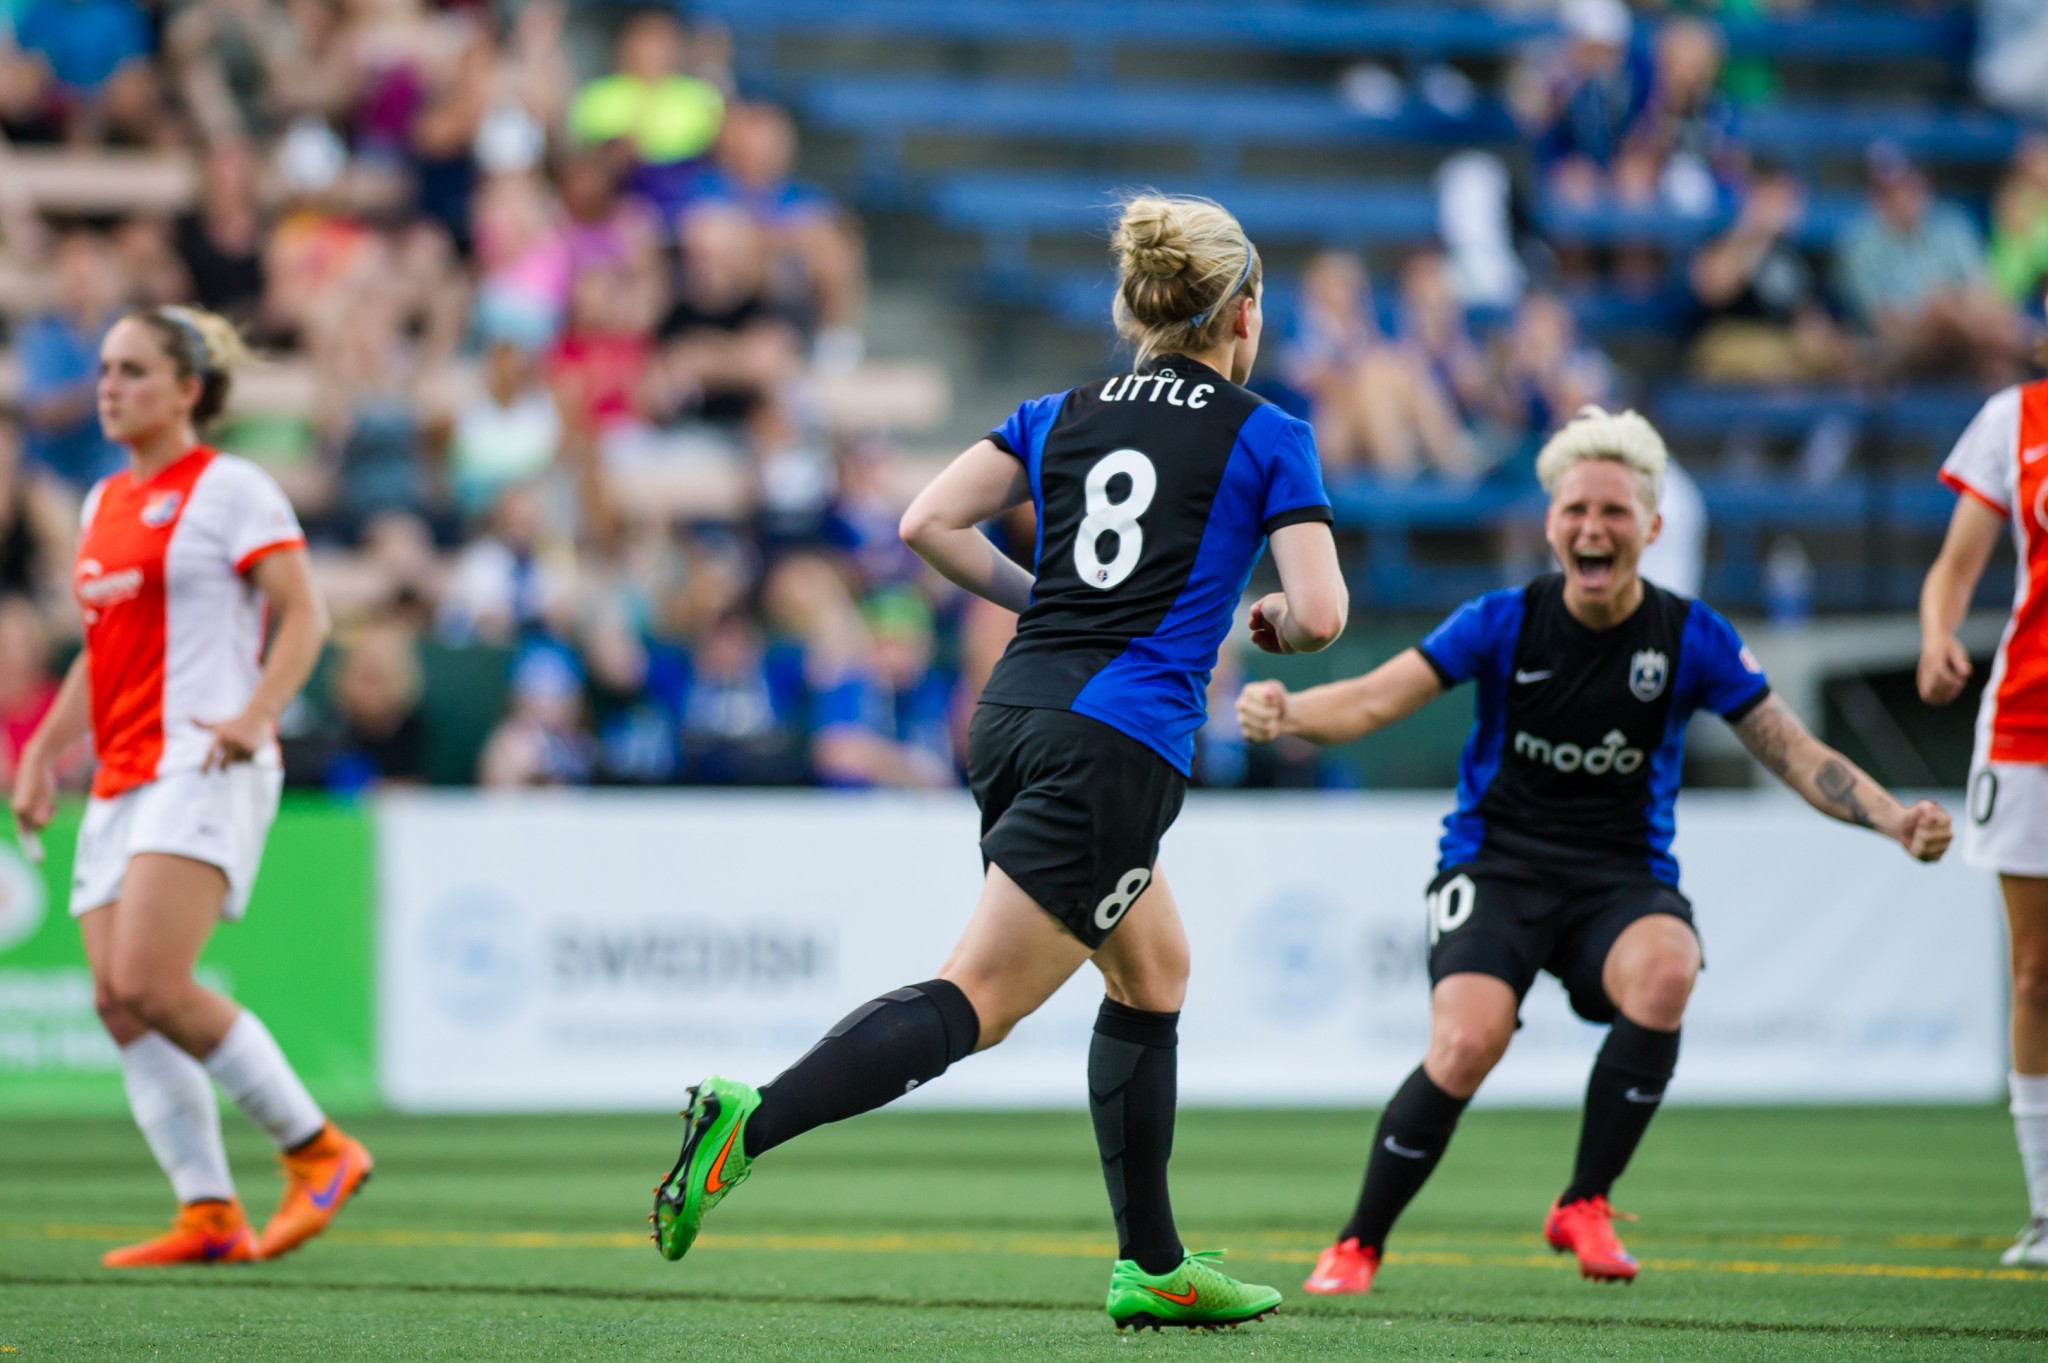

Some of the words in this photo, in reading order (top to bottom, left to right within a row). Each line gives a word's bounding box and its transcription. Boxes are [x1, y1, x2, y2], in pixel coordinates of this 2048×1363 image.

[1099, 373, 1215, 409] LITTLE
[1073, 448, 1157, 590] 8
[1094, 867, 1151, 930] 8
